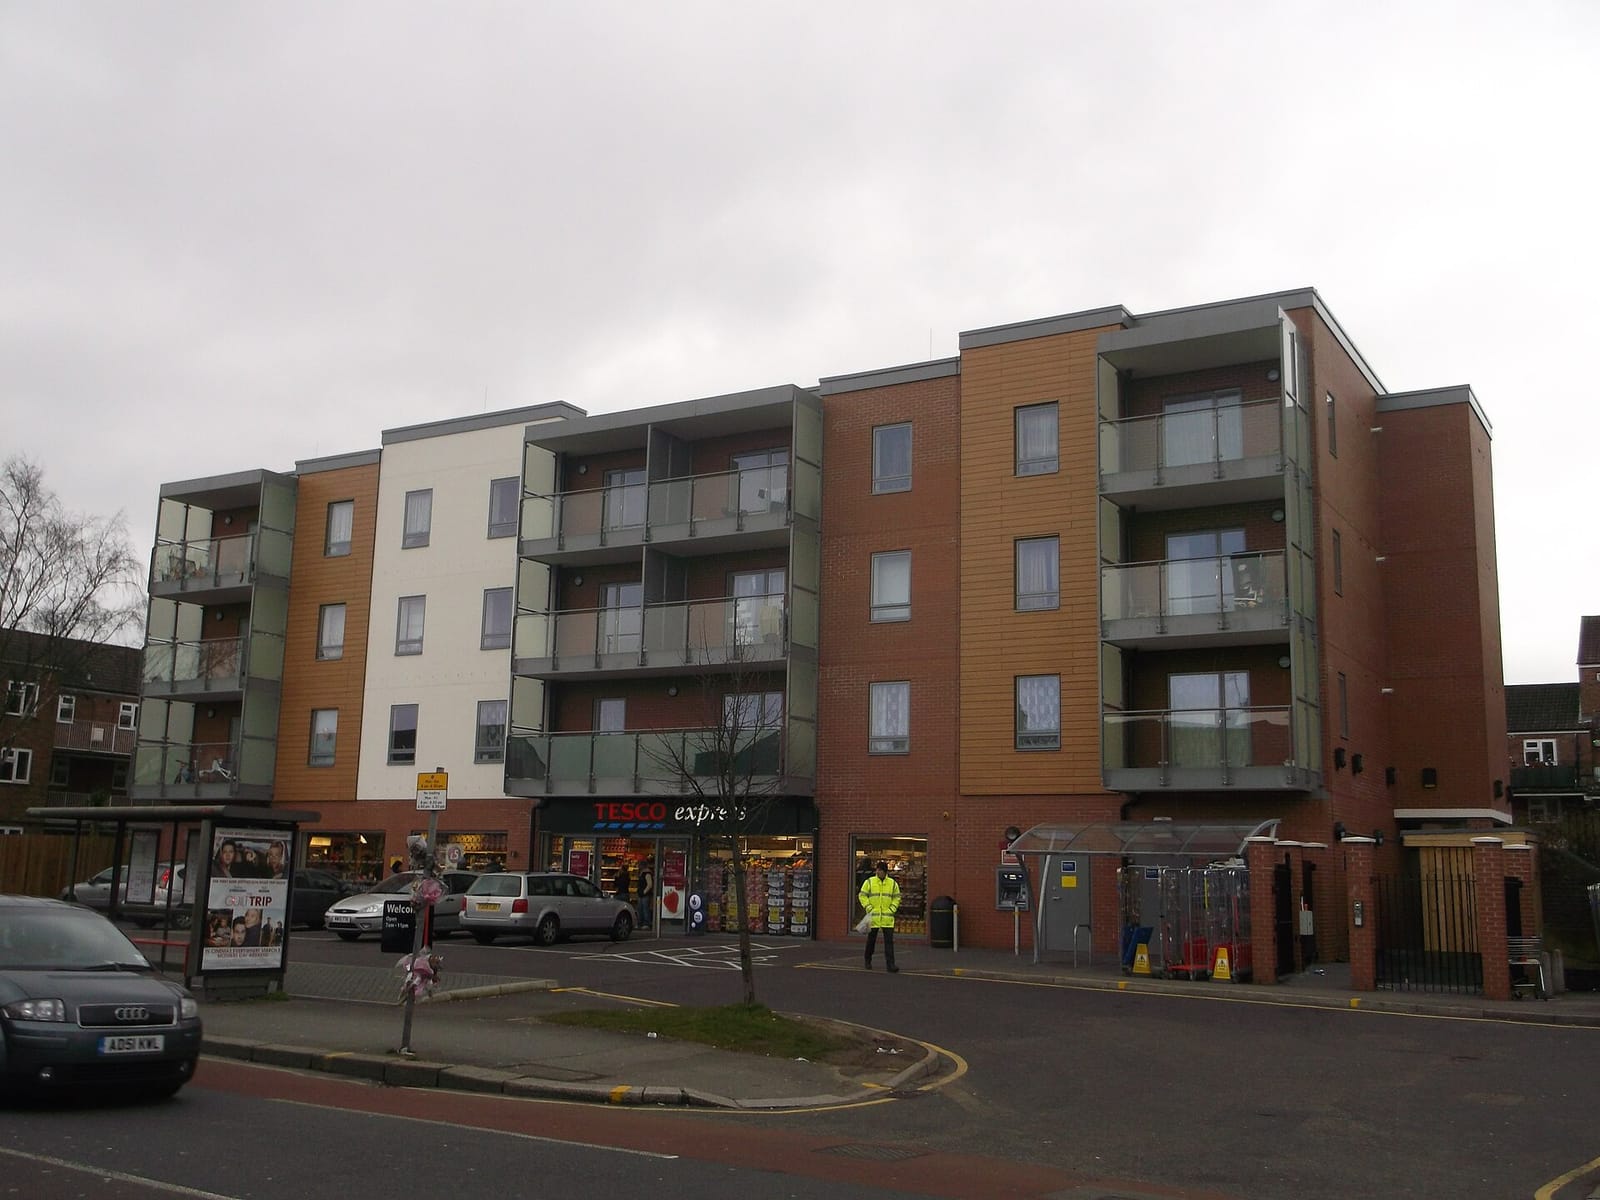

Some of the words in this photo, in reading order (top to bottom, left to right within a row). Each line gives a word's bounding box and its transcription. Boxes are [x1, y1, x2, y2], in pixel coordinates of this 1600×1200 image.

[595, 802, 667, 821] TESCO
[674, 803, 746, 827] expres
[249, 896, 273, 907] TRIP
[386, 903, 414, 914] Welco
[110, 1038, 136, 1050] AD51
[138, 1037, 160, 1049] KWL
